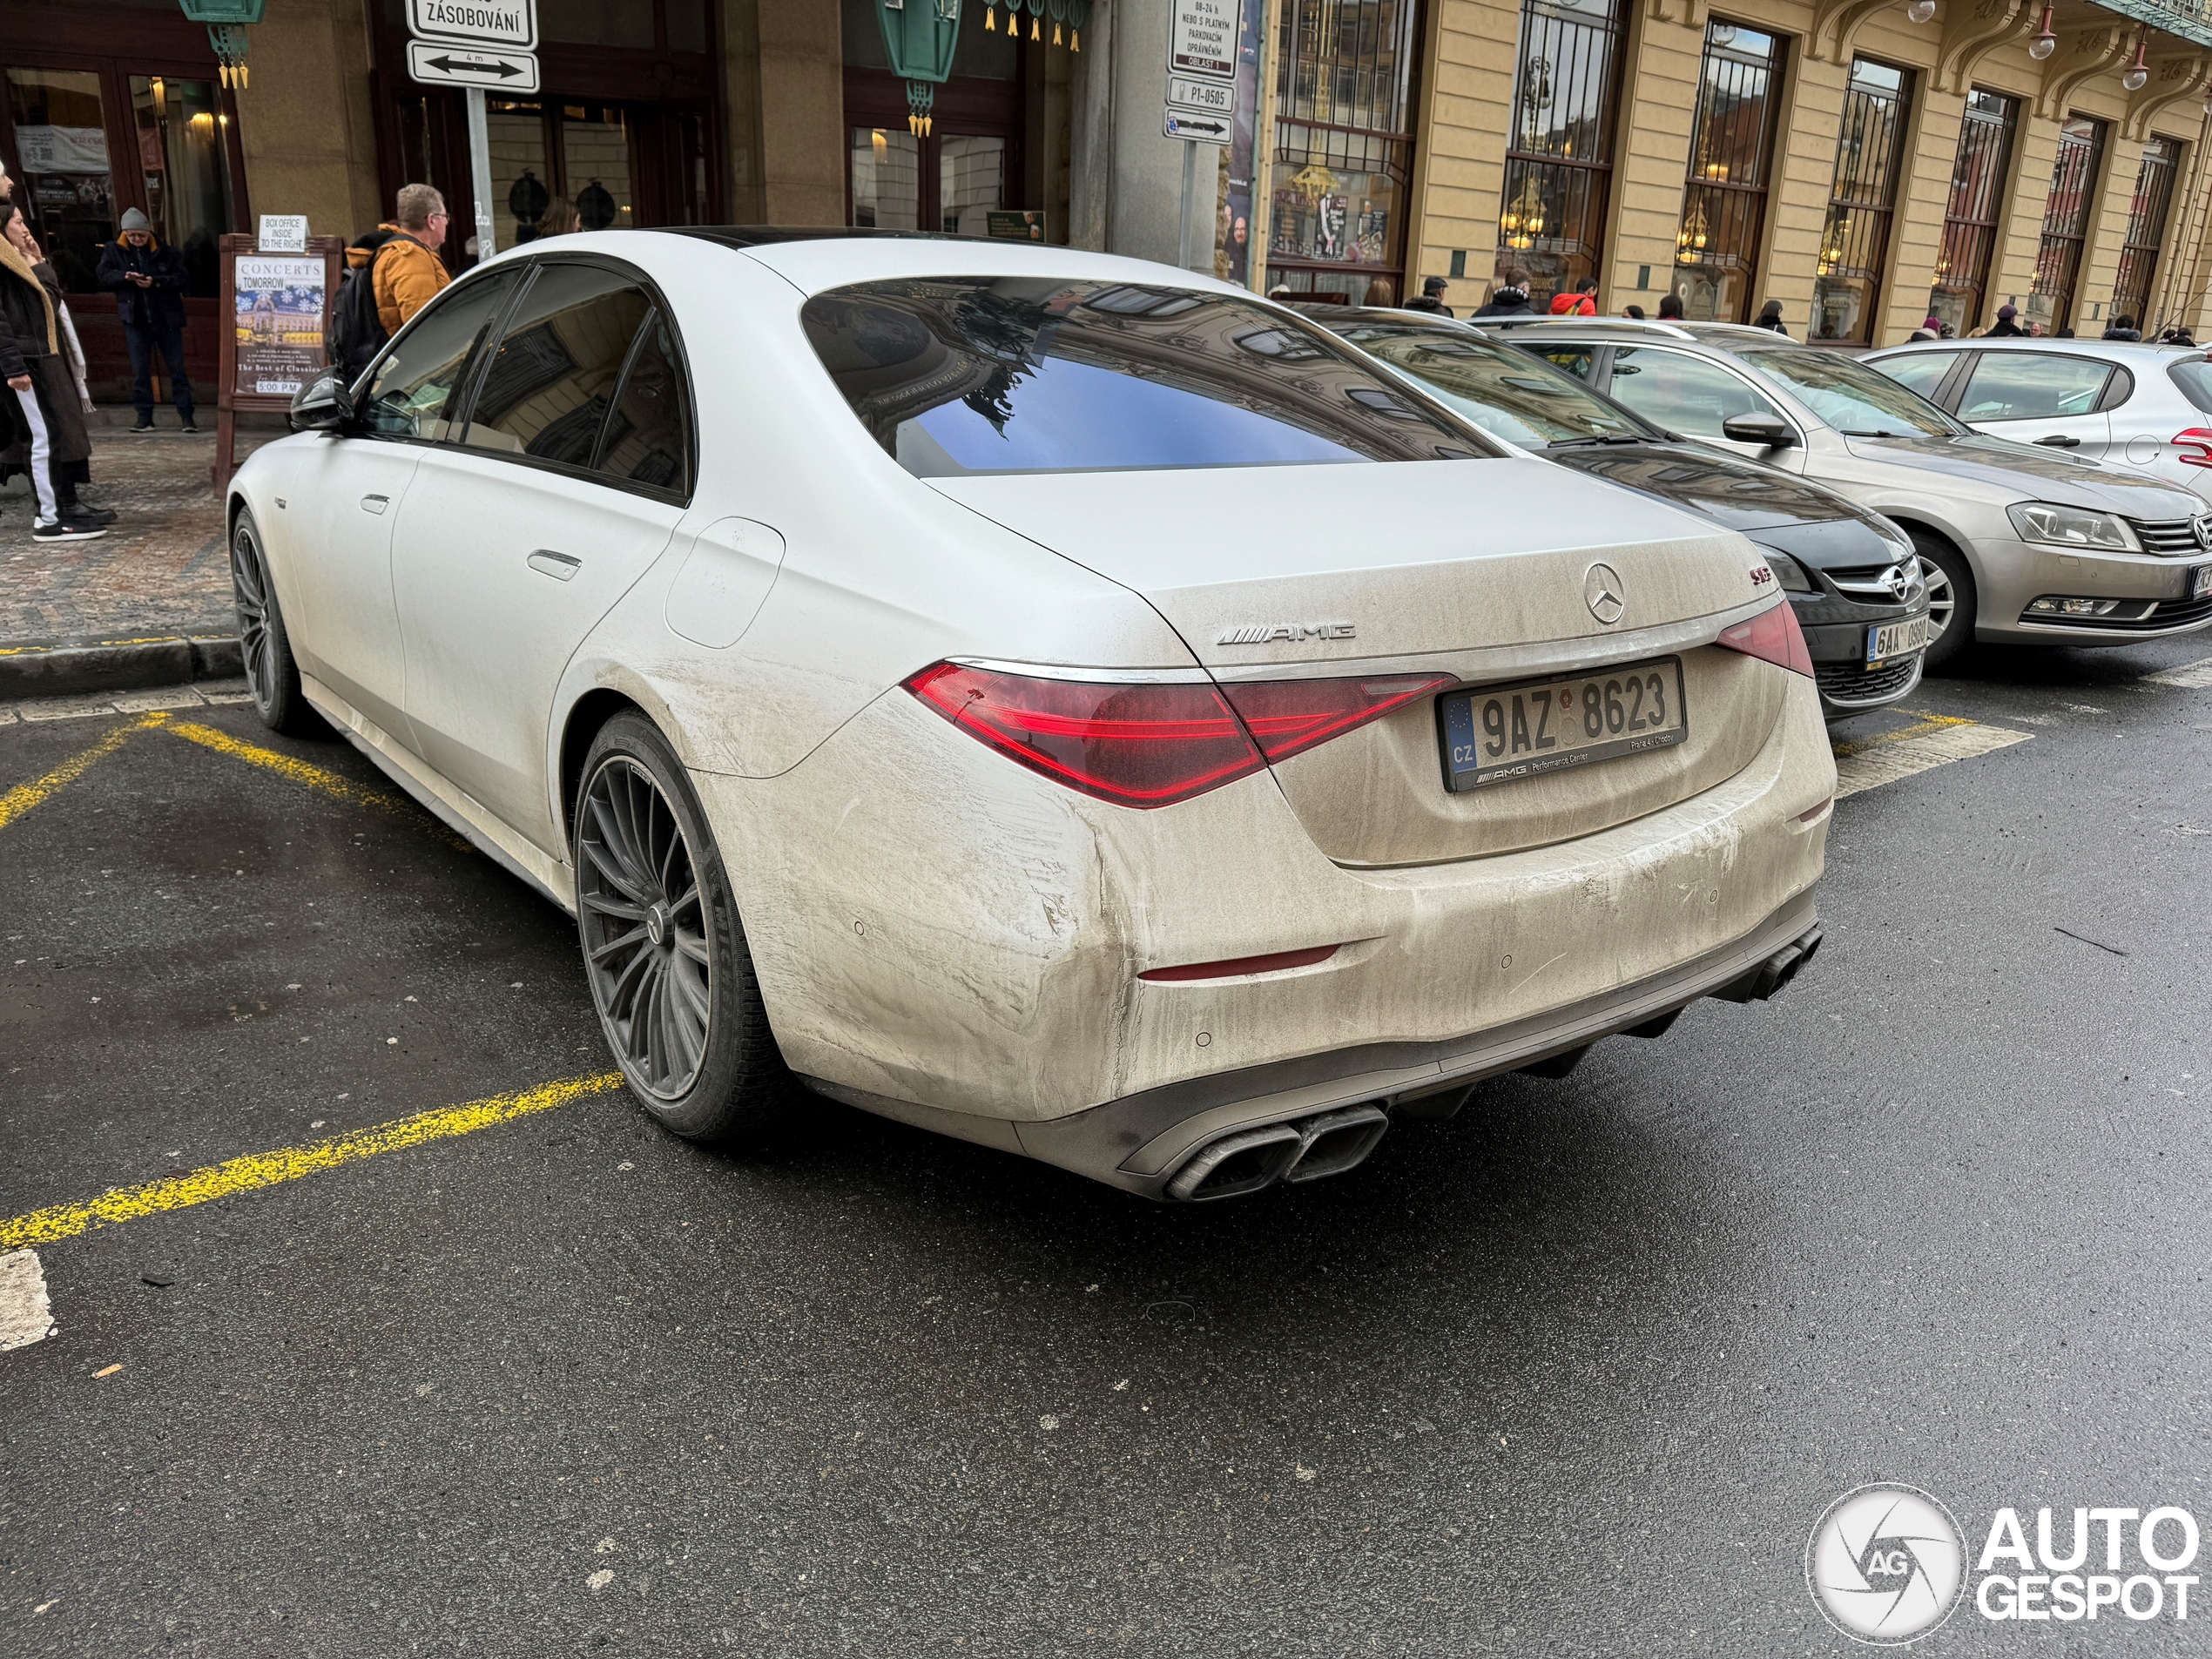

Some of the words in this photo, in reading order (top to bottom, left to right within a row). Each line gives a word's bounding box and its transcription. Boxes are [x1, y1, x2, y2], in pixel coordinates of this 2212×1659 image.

[1195, 2, 1212, 13] 08-24
[1215, 5, 1218, 14] h
[427, 0, 520, 32] ZÁSOBOVÁNÍ
[1182, 13, 1197, 24] NEBO
[1198, 16, 1204, 25] S
[1204, 17, 1230, 30] PLATNÝM
[1188, 29, 1222, 43] PARKOVACÍM
[1187, 42, 1222, 57] OPRÁVNĚNÍM
[1188, 57, 1213, 69] OBLAST
[1191, 86, 1224, 105] P1-0505
[266, 218, 277, 227] BOX
[279, 219, 300, 227] OFFICE
[272, 228, 292, 238] INSIDE
[261, 239, 269, 248] TO
[271, 239, 282, 248] THE
[283, 239, 302, 249] RIGHT
[240, 264, 320, 275] CONCERTS
[243, 277, 284, 288] TOMORROW
[1878, 627, 1899, 655] 6AA
[1482, 690, 1555, 757] 9AZ
[1581, 673, 1666, 738] 8623
[1453, 745, 1474, 764] CZ
[1532, 758, 1569, 772] Performance
[1569, 752, 1588, 764] Center
[1630, 739, 1647, 750] Praha
[1647, 738, 1651, 746] 4
[1655, 734, 1674, 745] Chodov
